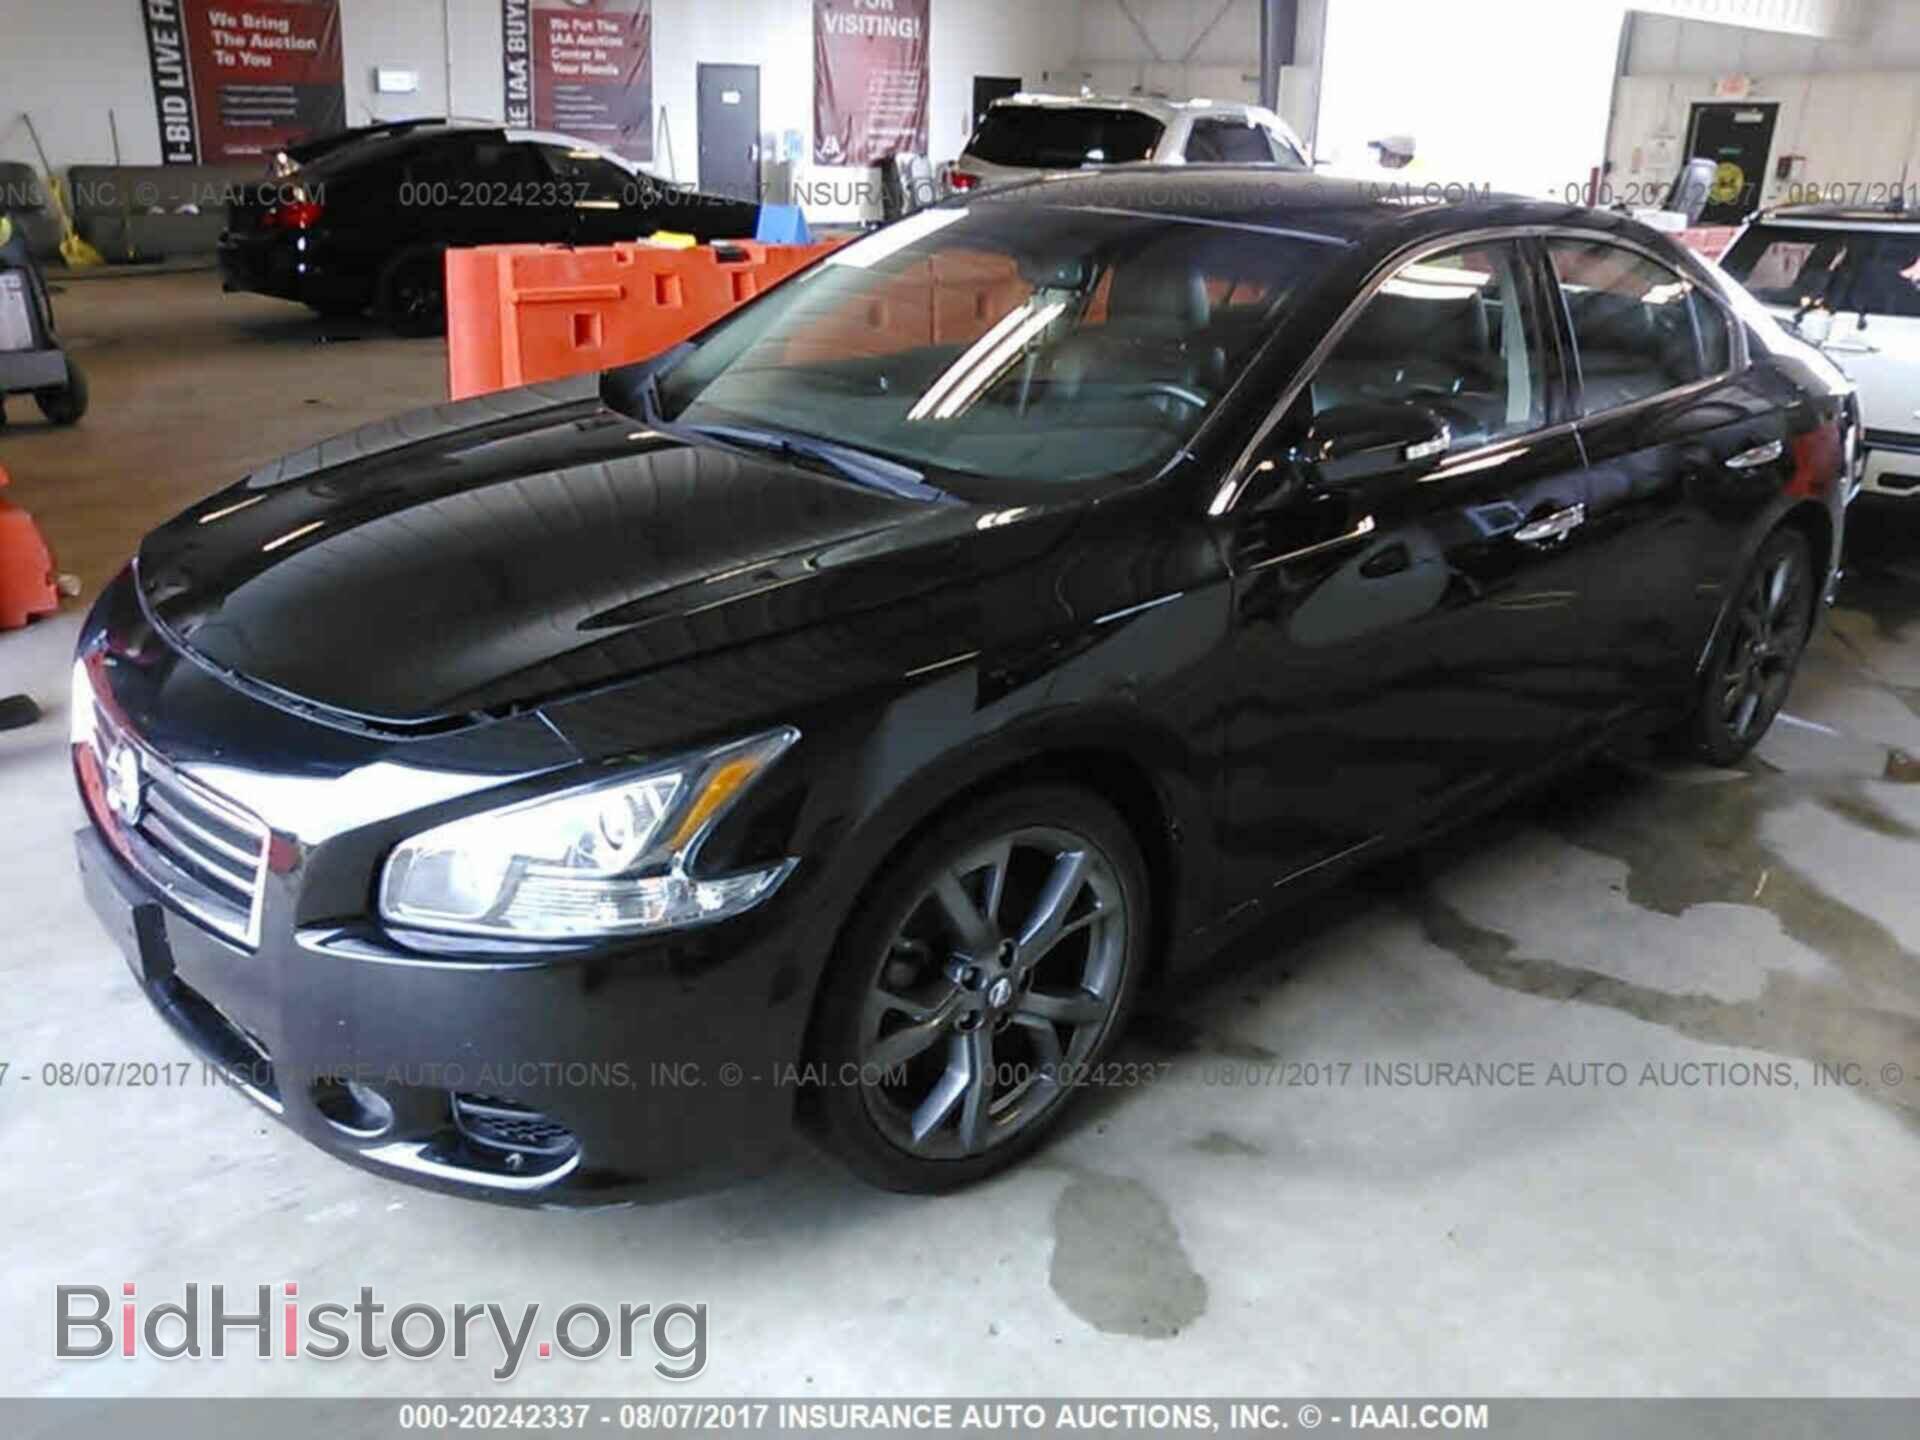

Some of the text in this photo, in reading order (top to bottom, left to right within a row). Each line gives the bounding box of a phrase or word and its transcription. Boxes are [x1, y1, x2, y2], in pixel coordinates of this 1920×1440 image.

[208, 11, 290, 33] We Bring
[506, 0, 526, 52] BUY
[823, 13, 921, 38] VISITING!
[211, 30, 317, 50] The Auction
[152, 27, 184, 88] LIVE
[214, 50, 273, 67] To You
[508, 58, 528, 99] IAA
[163, 96, 193, 162] I-BID
